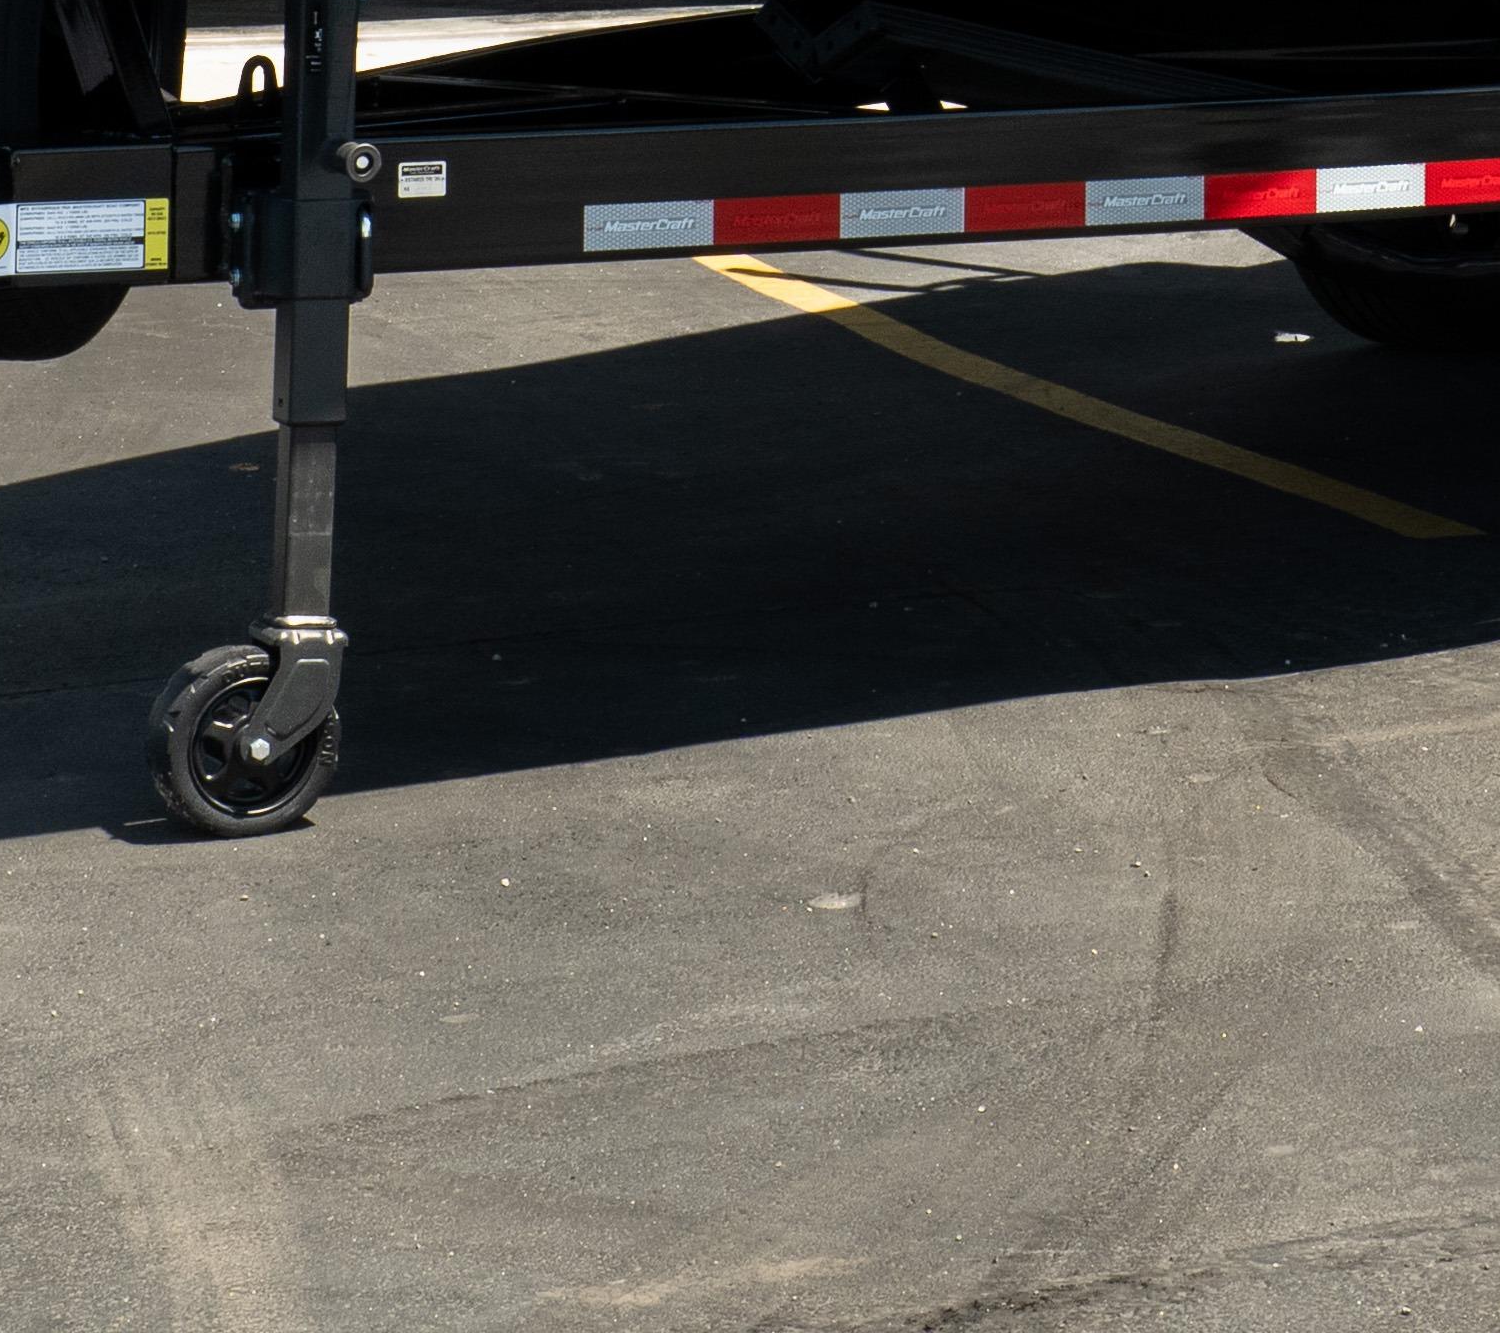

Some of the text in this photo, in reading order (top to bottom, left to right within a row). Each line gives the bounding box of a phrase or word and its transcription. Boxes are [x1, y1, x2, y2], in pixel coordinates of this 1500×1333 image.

[1333, 179, 1410, 196] MasterCraft
[1104, 192, 1187, 209] MasterCraft
[859, 205, 946, 221] MasterCraft
[604, 217, 695, 234] MasterCraft
